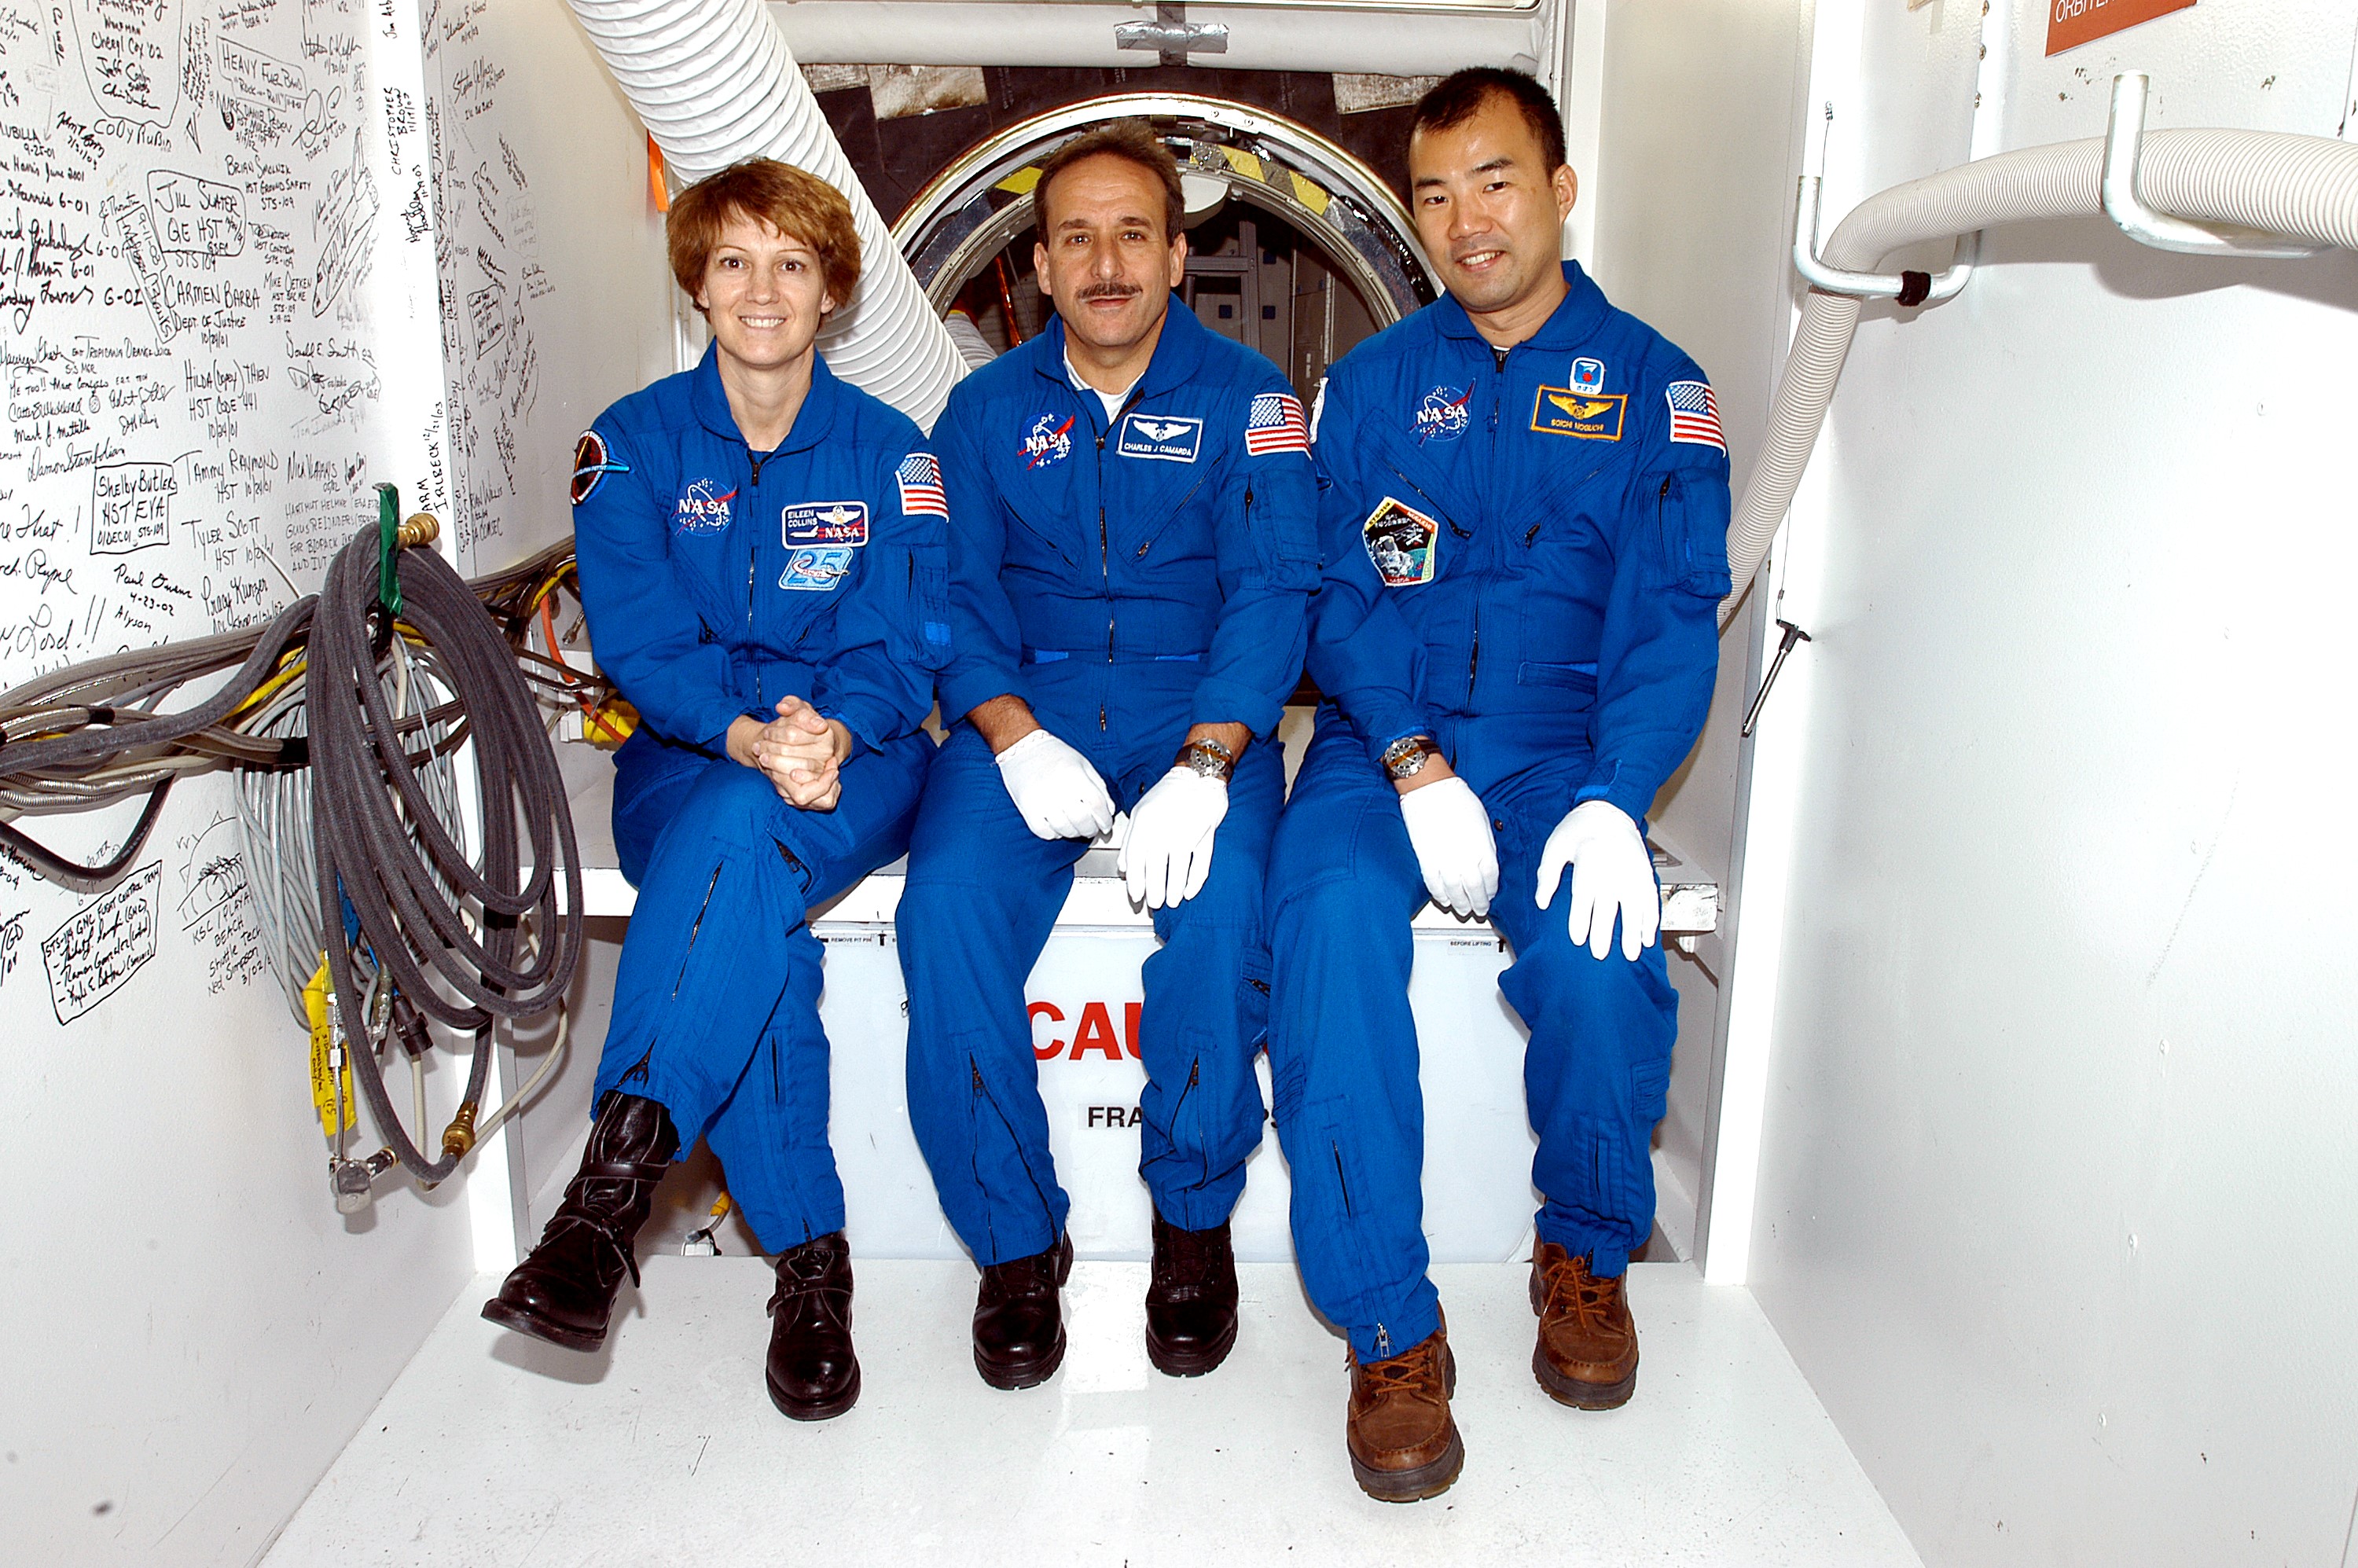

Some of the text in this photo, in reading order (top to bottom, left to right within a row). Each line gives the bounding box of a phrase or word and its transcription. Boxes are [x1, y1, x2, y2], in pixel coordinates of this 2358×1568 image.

[222, 43, 257, 79] HEAVY
[394, 88, 408, 135] BROWN
[59, 192, 89, 215] 6-01
[196, 215, 225, 242] HST
[72, 262, 94, 279] 6-01
[164, 275, 260, 310] CARMEN BARBA
[189, 395, 212, 421] HST
[1416, 404, 1468, 424] NASA
[1024, 432, 1071, 454] NASA
[1124, 442, 1192, 457] CHARLES J CAMARDA
[215, 481, 238, 504] HST
[102, 501, 131, 527] HST
[678, 498, 731, 516] NASA
[788, 509, 814, 520] EILEEN
[788, 518, 818, 528] COLLINS
[825, 527, 860, 539] NASA
[214, 547, 237, 573] HST
[114, 563, 144, 587] Paul
[130, 591, 174, 617] 4-23-02
[115, 604, 152, 633] Alyson
[214, 914, 244, 947] BEACH
